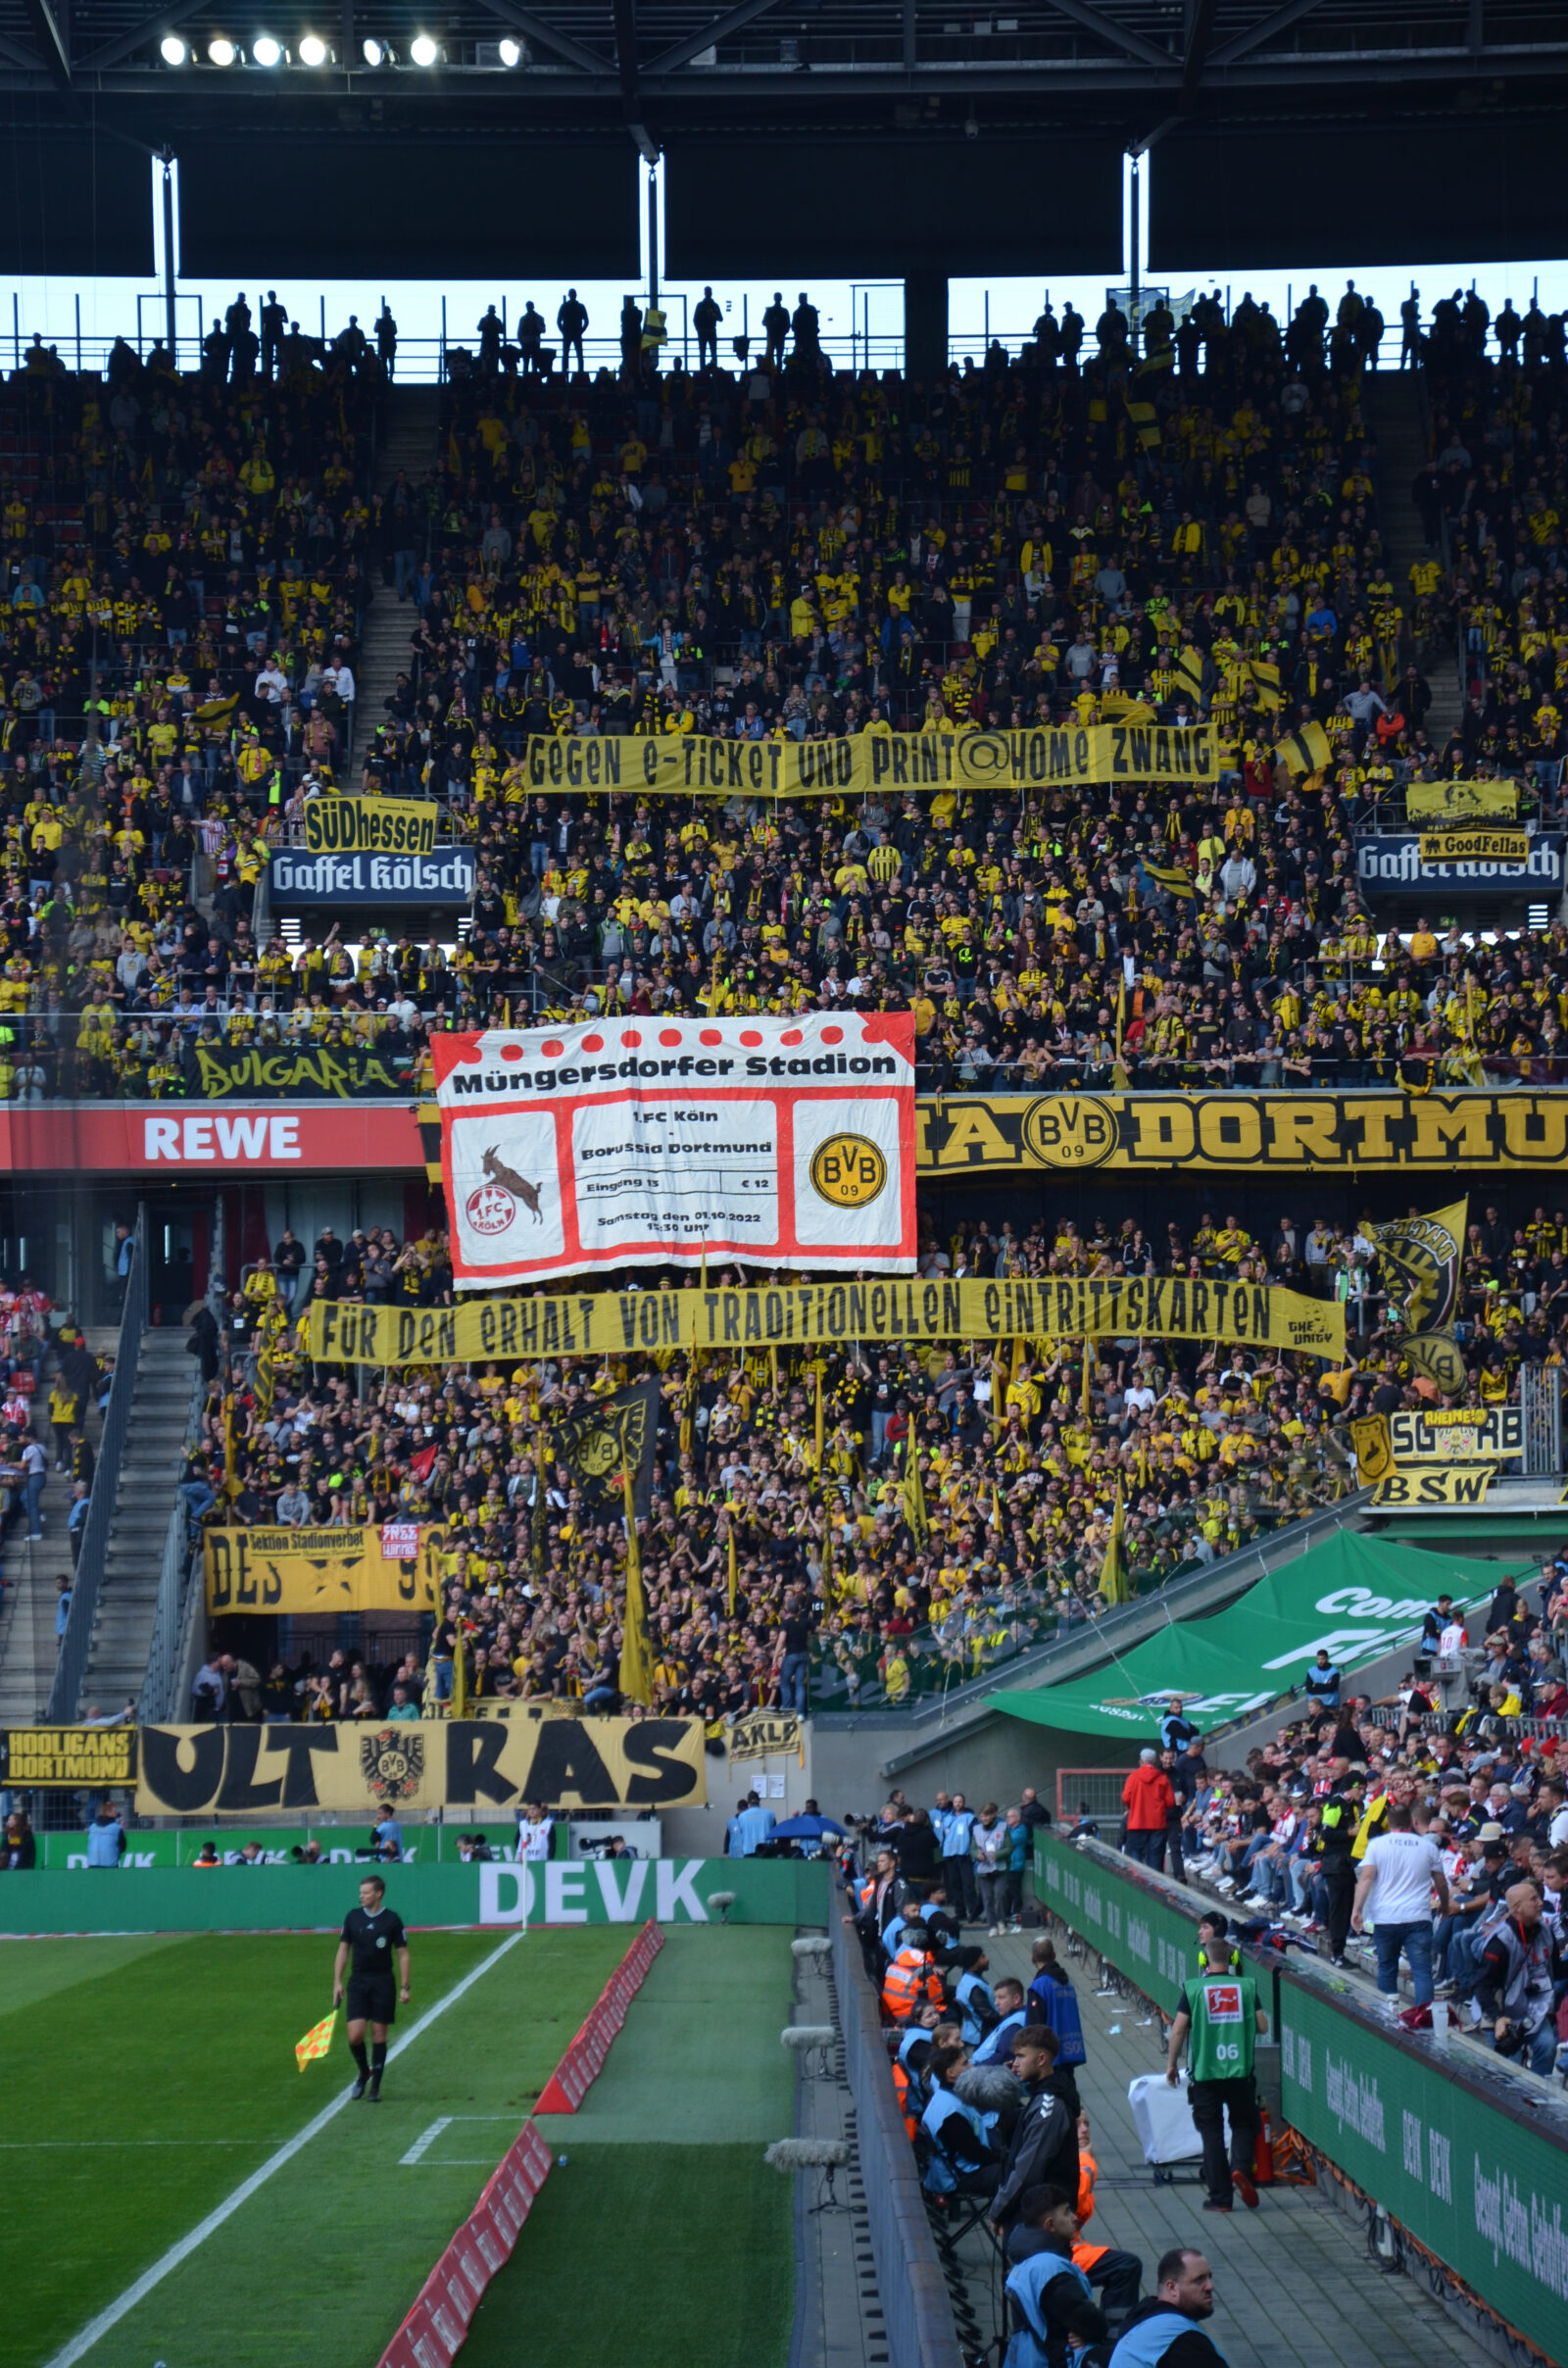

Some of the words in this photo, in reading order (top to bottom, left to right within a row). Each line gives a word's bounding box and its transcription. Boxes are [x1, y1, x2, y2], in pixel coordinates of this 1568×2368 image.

[798, 738, 853, 788] UND
[1112, 727, 1211, 775] ZWANG
[1446, 835, 1527, 854] GoodFellas
[273, 855, 366, 894] Gaffel
[370, 855, 472, 894] Kölsch
[453, 1056, 734, 1094] Müngersdorfer
[747, 1055, 896, 1076] Stadion
[633, 1111, 666, 1123] 1.FC
[674, 1110, 718, 1122] Köln
[1040, 1102, 1105, 1146] BVB
[144, 1115, 302, 1160] REWE
[581, 1142, 662, 1160] Borussia
[668, 1141, 772, 1154] Dortmund
[1061, 1145, 1084, 1158] 09
[824, 1145, 876, 1183] BVB
[587, 1179, 643, 1193] Eingang
[841, 1184, 858, 1196] 09
[598, 1211, 659, 1226] Samstag
[662, 1212, 690, 1221] den
[695, 1211, 760, 1222] 01.10.2022
[684, 1223, 710, 1232] Uhr
[321, 1305, 377, 1357] FÜR
[619, 1293, 679, 1348] VON
[1394, 1414, 1436, 1454] SG
[1381, 1471, 1490, 1504] BSW
[251, 1534, 289, 1551] Sektion
[382, 1525, 417, 1541] FREE
[9, 1732, 129, 1755] HOOLIGANS
[9, 1755, 129, 1779] DORTMUND
[479, 1859, 710, 1924] DEVK
[1216, 2044, 1239, 2060] 06
